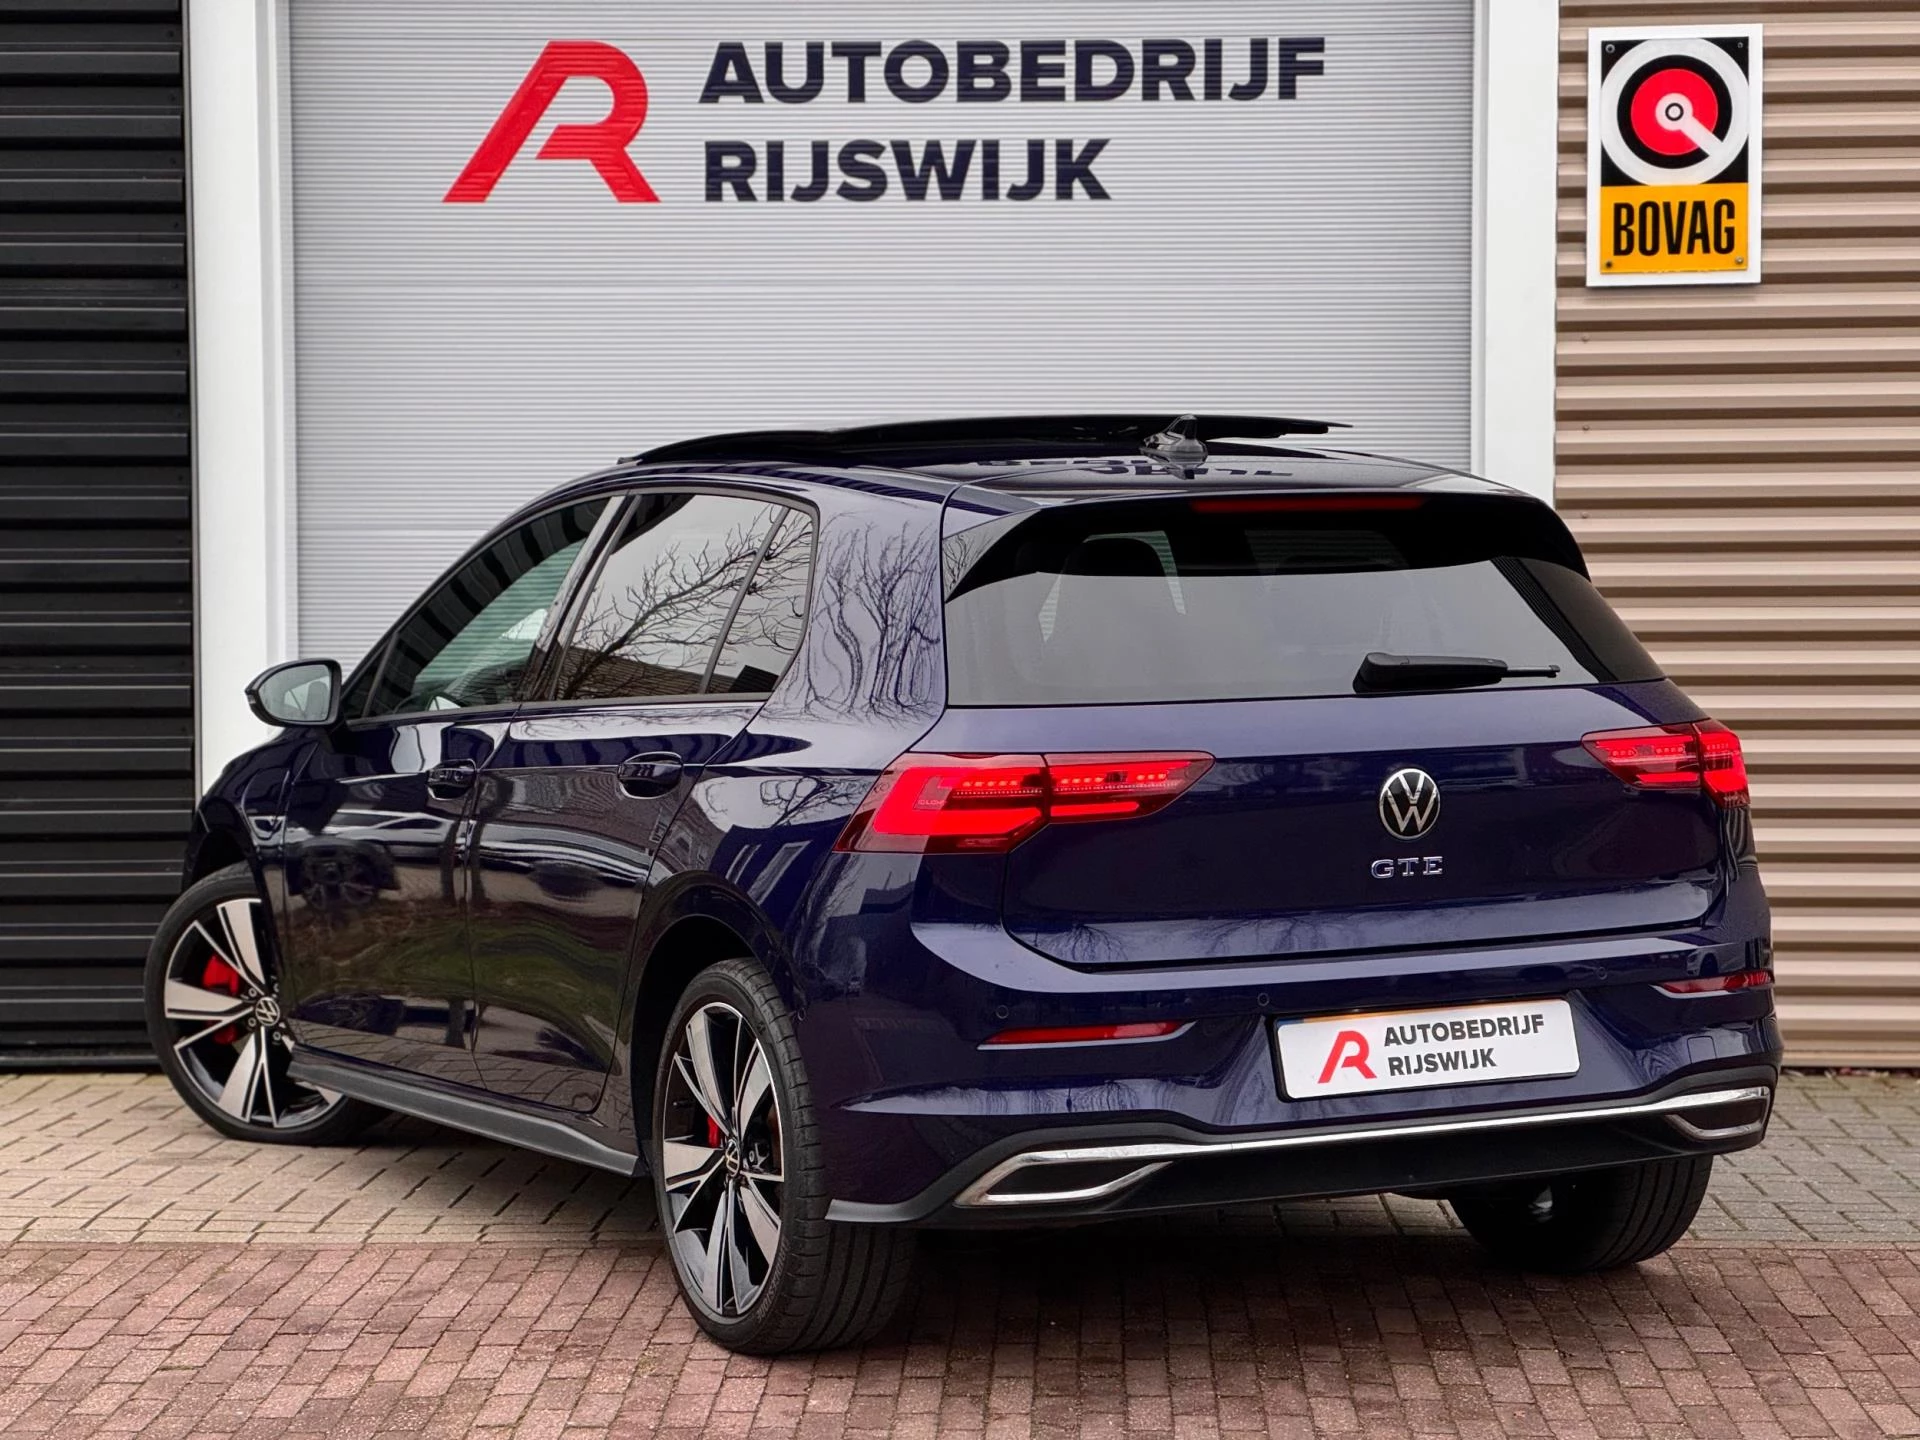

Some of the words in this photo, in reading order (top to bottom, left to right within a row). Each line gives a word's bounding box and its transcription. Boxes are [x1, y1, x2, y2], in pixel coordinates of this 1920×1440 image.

[699, 37, 1325, 104] AUTOBEDRIJF
[704, 138, 1112, 203] RIJSWIJK
[1612, 199, 1736, 256] BOVAG
[1371, 856, 1443, 879] GTE
[1383, 1013, 1545, 1047] AUTOBEDRIJF
[1387, 1047, 1497, 1077] RIJSWIJK
